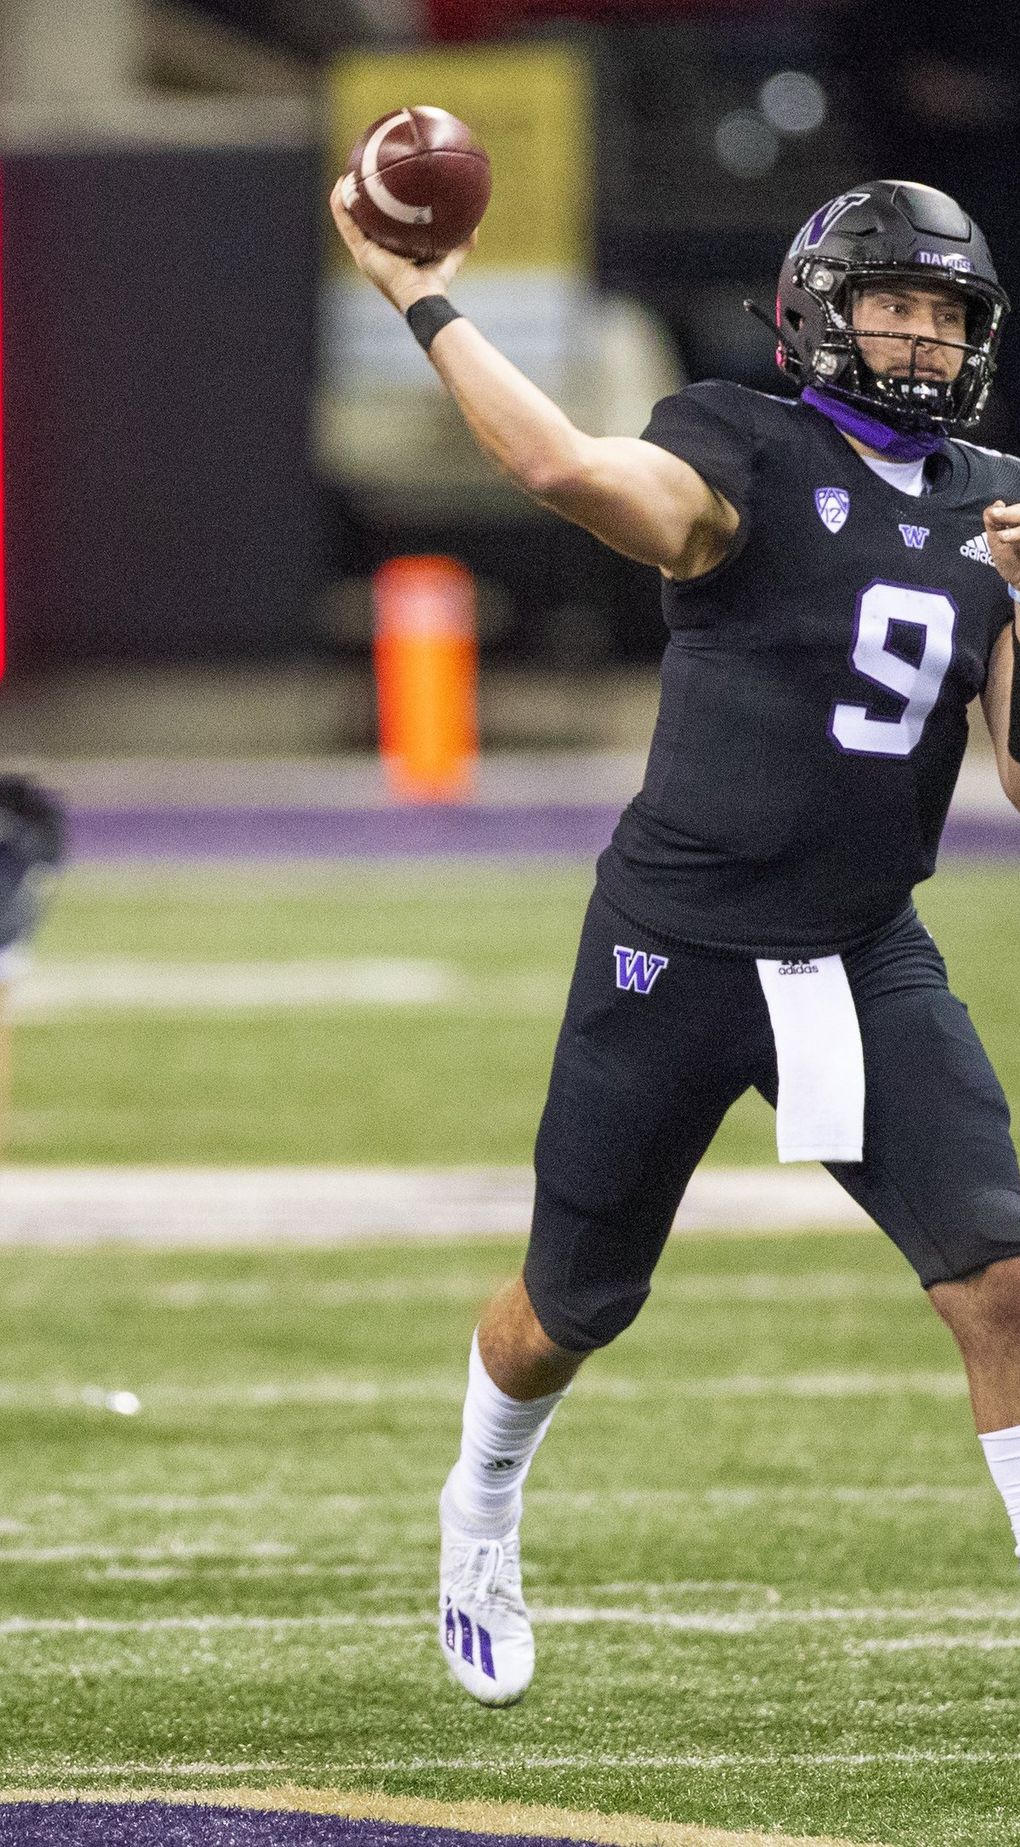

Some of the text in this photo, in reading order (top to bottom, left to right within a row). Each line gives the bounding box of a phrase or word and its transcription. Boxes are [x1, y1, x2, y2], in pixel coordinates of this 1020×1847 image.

[816, 489, 850, 514] PAC
[824, 507, 842, 524] 12
[898, 524, 930, 550] W
[959, 544, 996, 567] adida
[827, 577, 960, 760] 9
[612, 945, 669, 995] W
[778, 962, 819, 976] adidas
